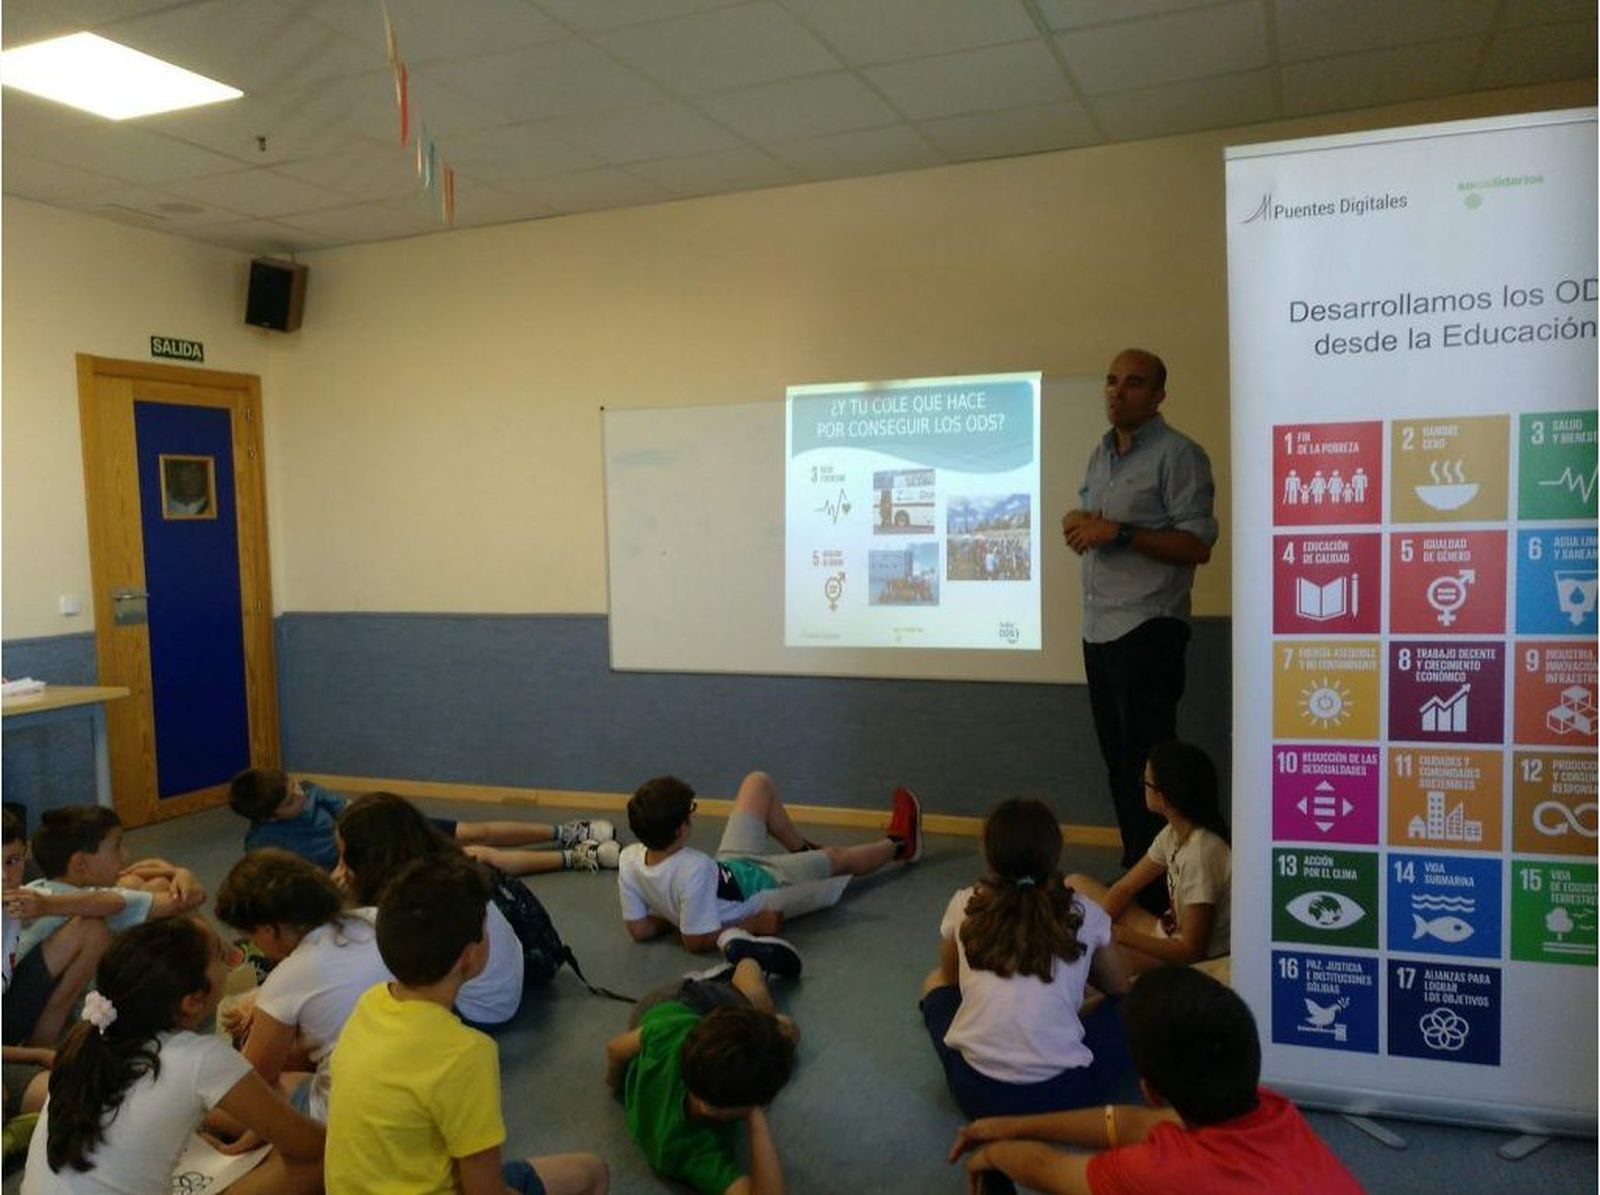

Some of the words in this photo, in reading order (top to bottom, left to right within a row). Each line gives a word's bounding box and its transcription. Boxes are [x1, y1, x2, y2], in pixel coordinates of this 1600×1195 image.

[1274, 202, 1335, 219] Puentes
[1340, 194, 1408, 215] Digitales
[1289, 291, 1492, 324] Desarrollamos
[1503, 285, 1544, 308] los
[1314, 331, 1398, 356] desde
[1409, 328, 1431, 350] la
[1443, 316, 1597, 348] Educación
[152, 338, 203, 360] SALIDA
[830, 401, 846, 418] ¿Y
[851, 399, 867, 416] TU
[872, 397, 908, 415] COLE
[913, 394, 943, 414] QUE
[947, 391, 986, 410] HACE
[817, 421, 846, 438] POR
[849, 417, 930, 438] CONSEGUIR
[934, 415, 961, 434] LOS
[966, 412, 1006, 432] ODS?
[1531, 420, 1544, 445] 3
[1552, 418, 1583, 431] SALUD
[1284, 431, 1293, 455] 1
[1297, 431, 1311, 442] FIN
[1402, 426, 1414, 450] 2
[1552, 432, 1559, 446] Y
[1297, 444, 1308, 455] DE
[1310, 443, 1320, 454] LA
[1322, 441, 1359, 453] POBREZA
[1303, 539, 1349, 552] EDUCACIÓN
[1423, 538, 1468, 549] IGUALDAD
[1528, 536, 1542, 560] 6
[1554, 536, 1579, 548] AGUA
[1282, 541, 1295, 564] 4
[1303, 553, 1313, 564] DE
[1315, 552, 1350, 564] CALIDAD
[1401, 539, 1414, 562] 5
[1423, 551, 1434, 562] DE
[1437, 549, 1472, 562] GÉNERO
[1554, 549, 1560, 560] Y
[1283, 648, 1295, 671] 7
[1398, 647, 1412, 671] 8
[1416, 647, 1457, 660] TRABAJO
[1458, 648, 1497, 660] DECENTE
[1526, 648, 1539, 672] 9
[1416, 660, 1423, 670] Y
[1424, 659, 1482, 671] CRECIMIENTO
[1415, 669, 1467, 682] ECONÓMICO
[1277, 751, 1298, 774] 10
[1302, 752, 1348, 764] REDUCCIÓN
[1349, 753, 1360, 764] DE
[1361, 753, 1378, 766] LAS
[1395, 754, 1413, 776] 11
[1464, 756, 1470, 767] Y
[1302, 763, 1368, 777] DESIGUALDADES
[1521, 759, 1543, 782] 12
[1552, 771, 1558, 782] Y
[1278, 853, 1298, 877] 13
[1303, 854, 1335, 867] ACCIÓN
[1423, 860, 1446, 874] VIDA
[1303, 866, 1320, 878] POR
[1321, 867, 1332, 879] EL
[1332, 868, 1358, 881] CLIMA
[1394, 860, 1416, 884] 14
[1520, 868, 1543, 892] 15
[1551, 869, 1571, 881] VIDA
[1423, 873, 1475, 888] SUBMARINA
[1278, 957, 1300, 980] 16
[1306, 959, 1323, 972] PAZ,
[1326, 960, 1364, 974] JUSTICIA
[1312, 970, 1373, 987] INSTITUCIONES
[1396, 966, 1417, 990] 17
[1424, 969, 1466, 983] ALIANZAS
[1467, 971, 1491, 985] PARA
[1305, 981, 1341, 995] SÓLIDAS
[1424, 980, 1459, 993] LOGRAR
[1424, 991, 1440, 1003] LOS
[1441, 992, 1490, 1008] OBJETIVOS
